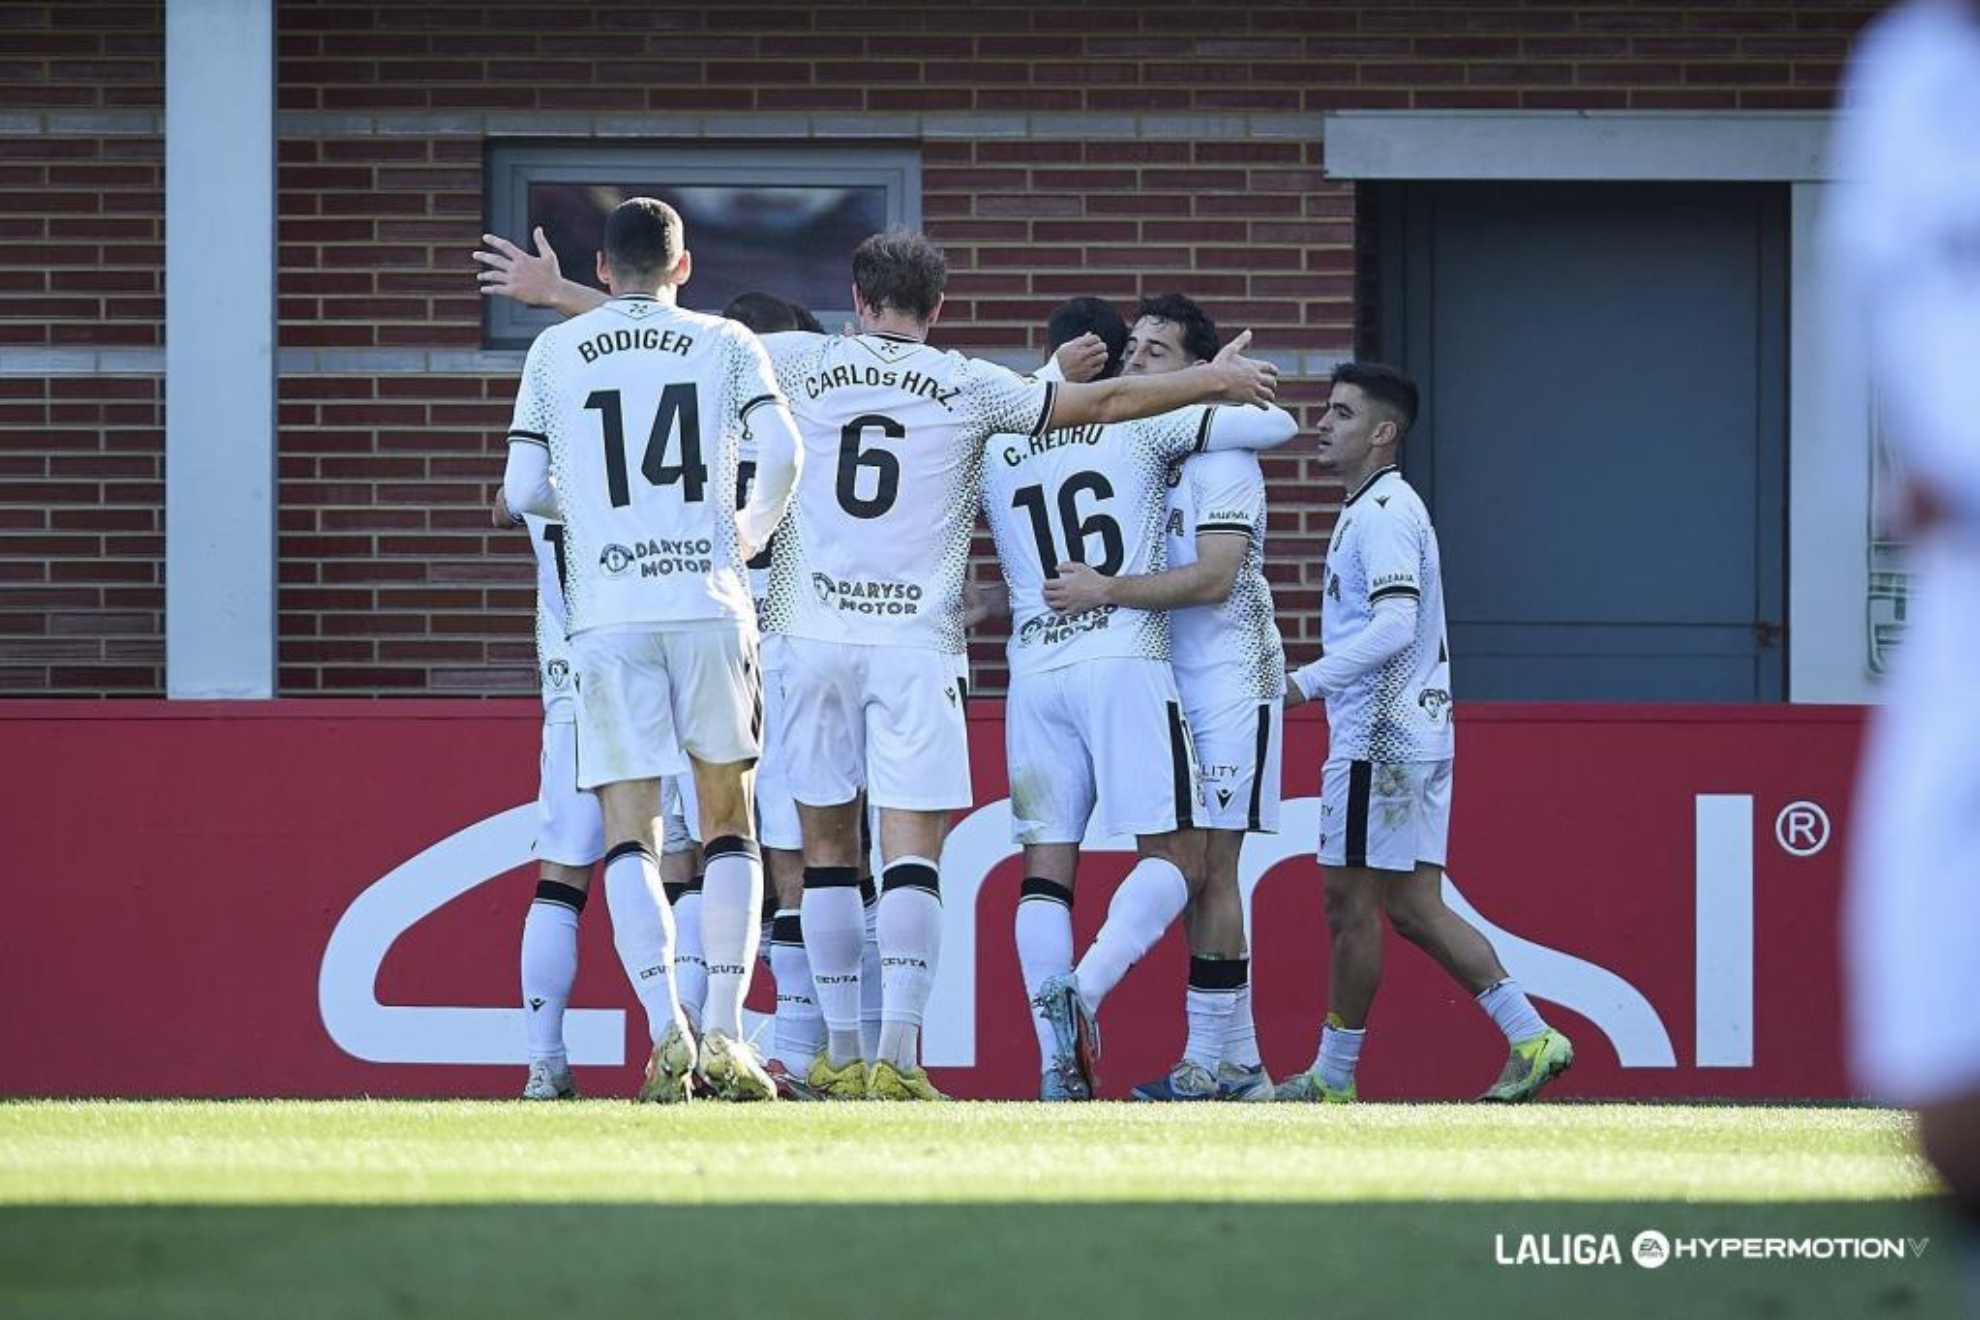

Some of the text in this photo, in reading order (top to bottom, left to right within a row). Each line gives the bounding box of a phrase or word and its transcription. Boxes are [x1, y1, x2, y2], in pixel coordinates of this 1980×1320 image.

[577, 328, 694, 364] BODIGER
[583, 382, 708, 508] 14
[836, 414, 906, 518] 6
[1011, 470, 1125, 579] 16
[635, 538, 712, 558] DARYSO
[640, 558, 712, 578] MOTOR
[838, 581, 923, 601] DARYSO
[838, 598, 918, 615] MOTOR
